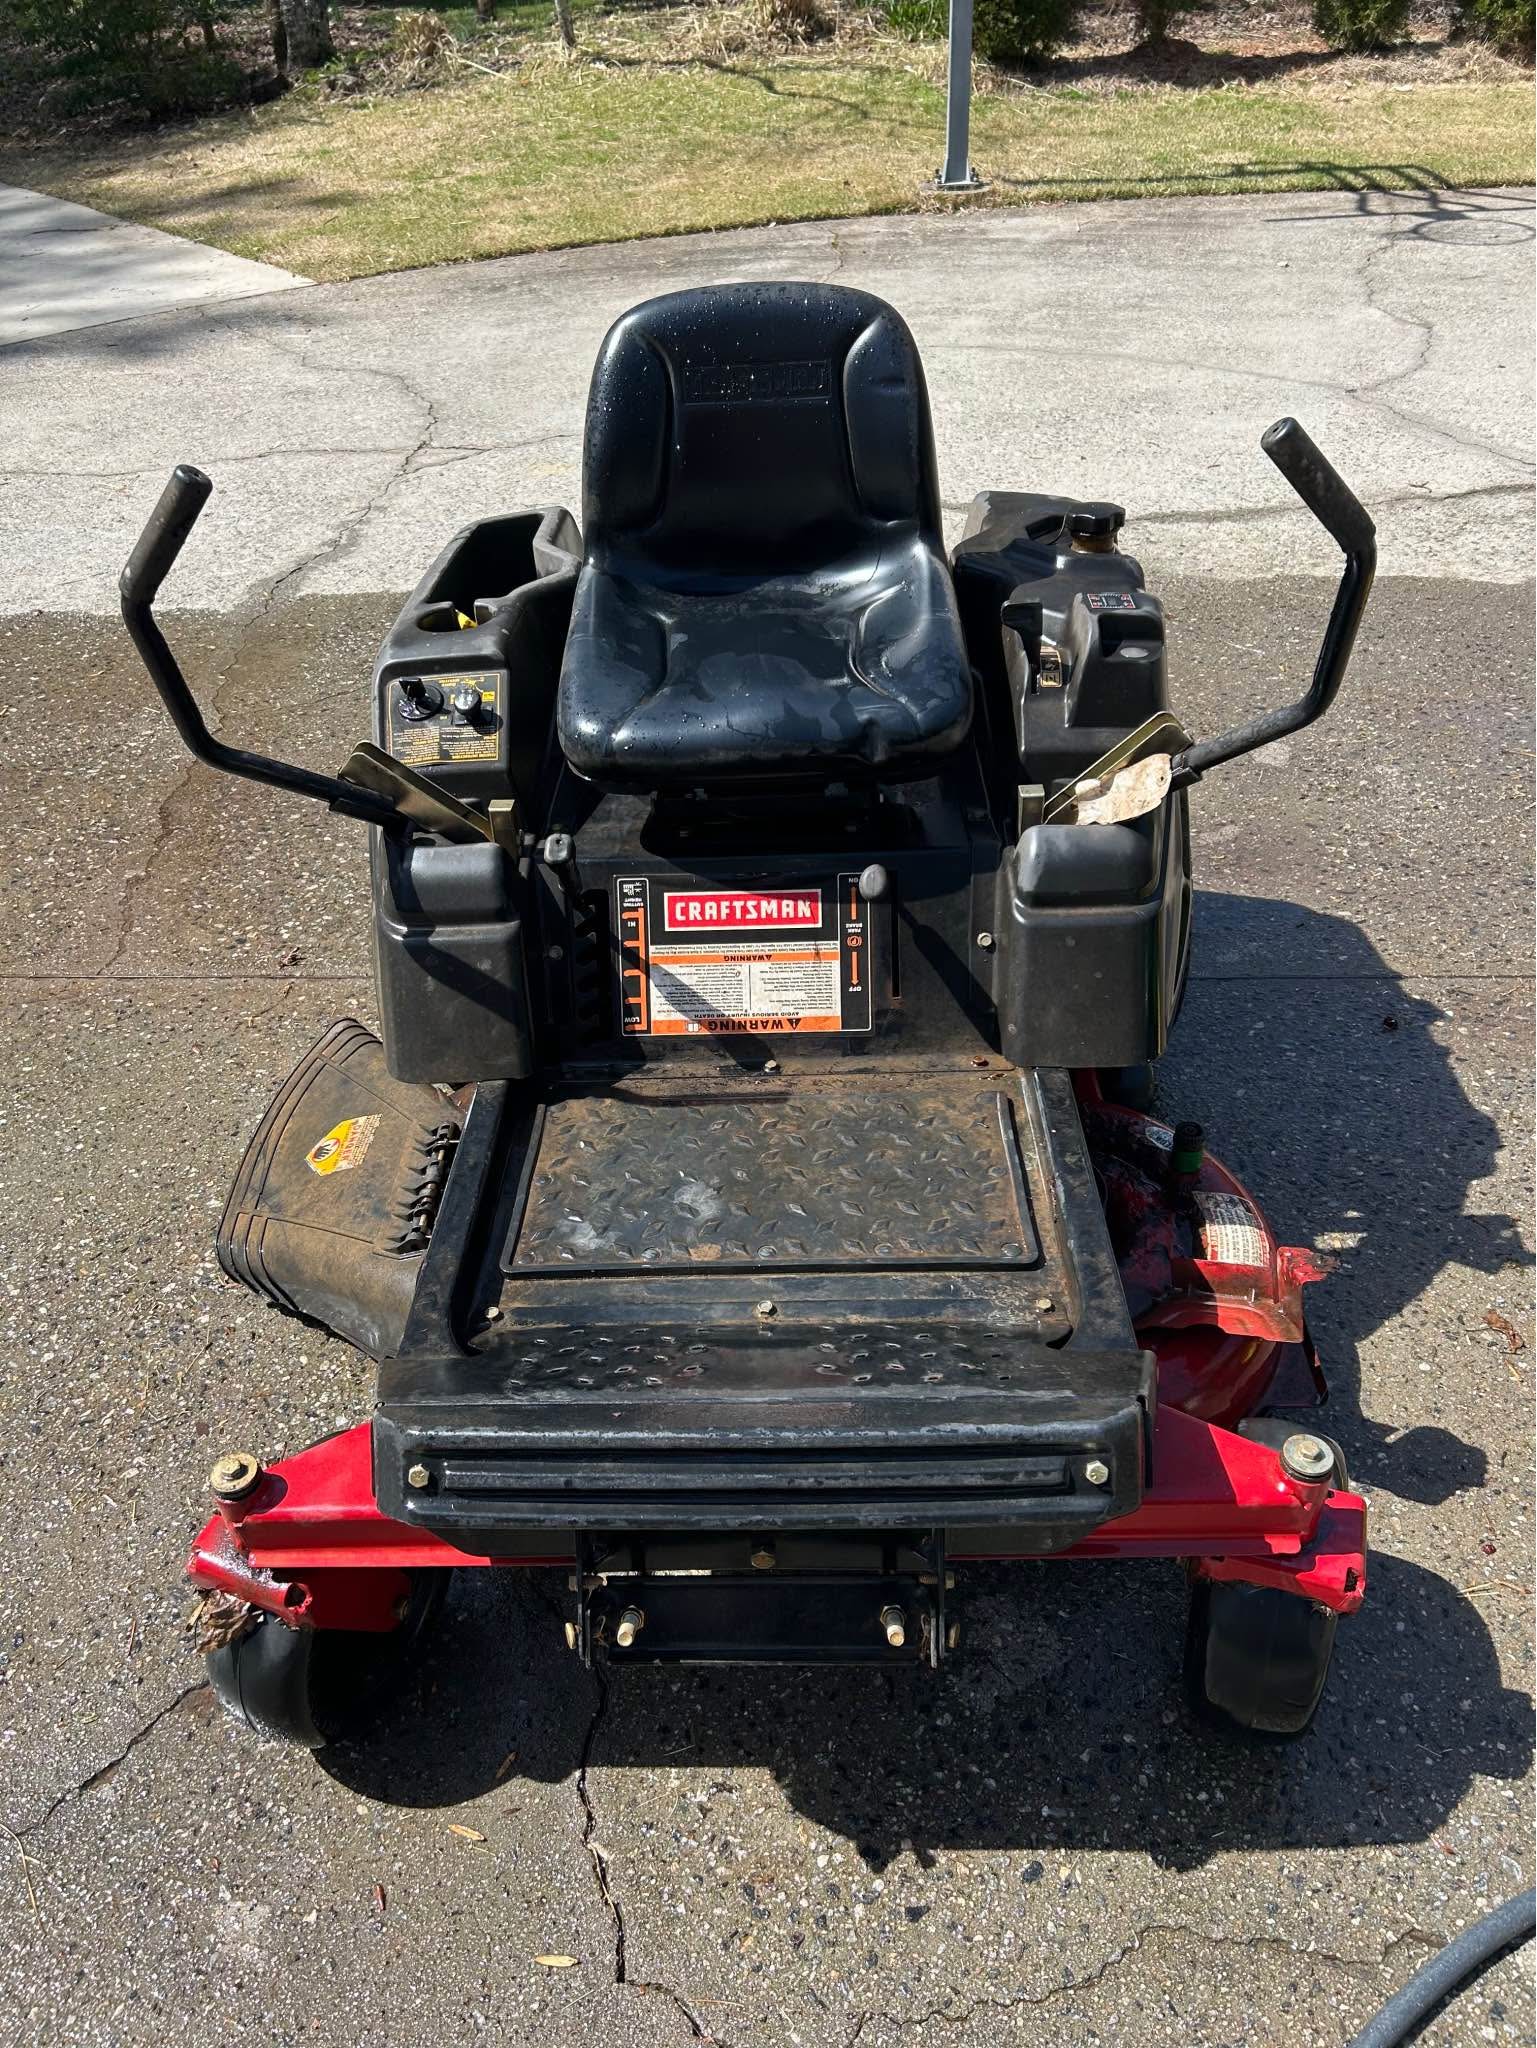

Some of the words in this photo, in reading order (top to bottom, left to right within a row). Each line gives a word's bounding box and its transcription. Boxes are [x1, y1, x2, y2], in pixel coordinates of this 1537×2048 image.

[675, 900, 812, 921] CRAFTSMAN
[723, 954, 765, 962] WARNING
[708, 1019, 783, 1031] WARNING
